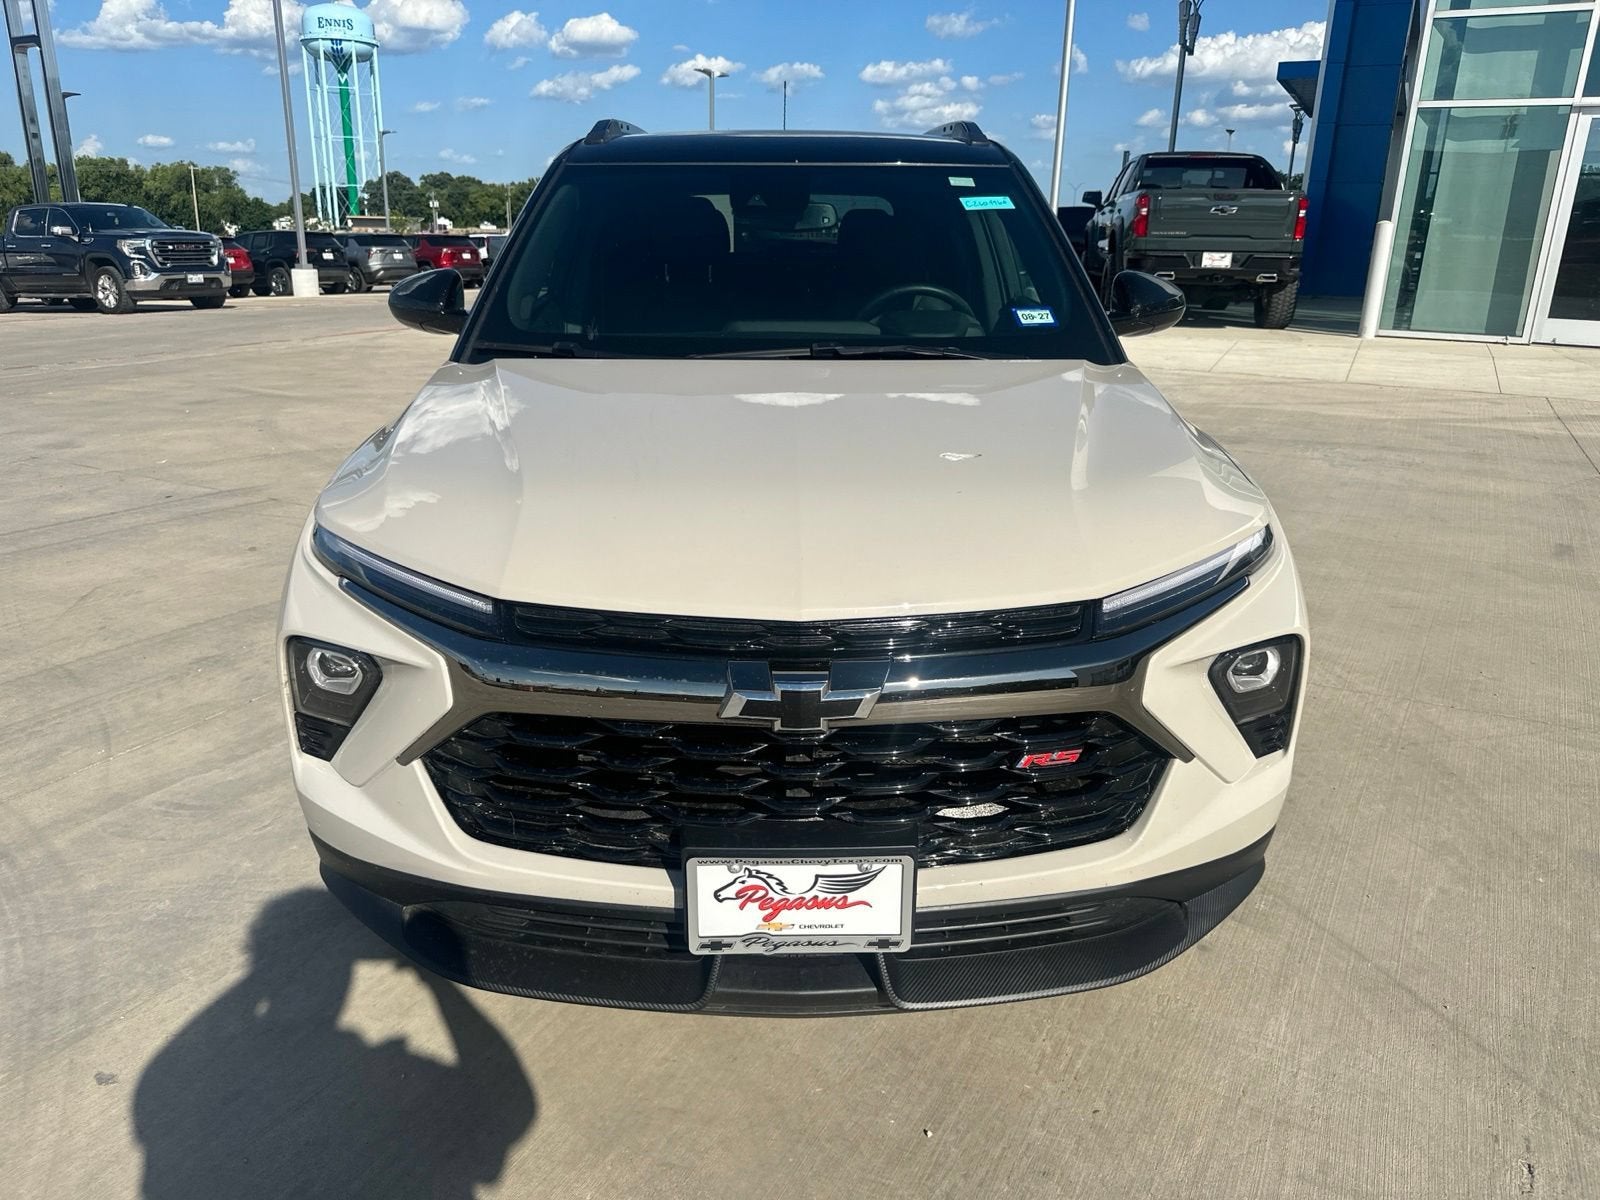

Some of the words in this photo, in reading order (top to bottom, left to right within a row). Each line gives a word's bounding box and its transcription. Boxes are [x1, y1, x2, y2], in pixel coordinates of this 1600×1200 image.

[317, 16, 353, 30] ENNIS
[1016, 749, 1083, 768] RS
[697, 858, 903, 866] www.PegasusChevyTexas.com
[735, 885, 872, 923] Pegasus
[741, 936, 858, 952] Pegasus
